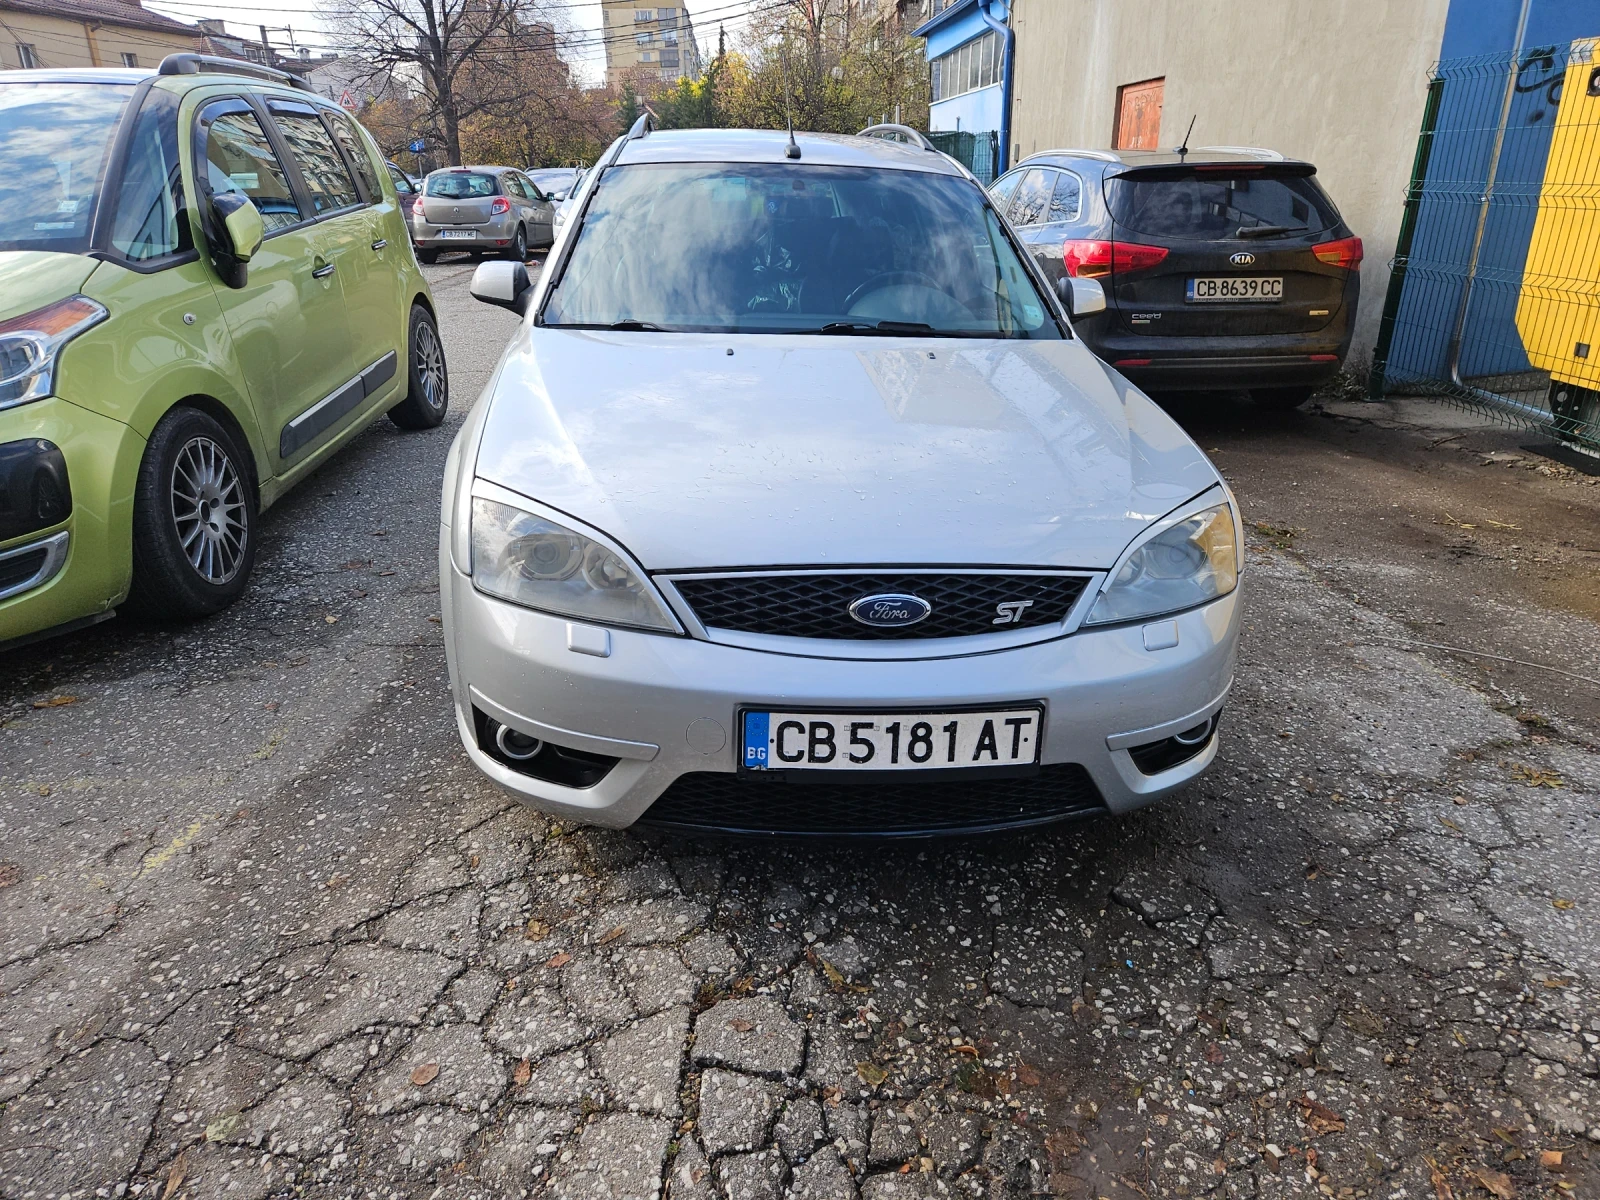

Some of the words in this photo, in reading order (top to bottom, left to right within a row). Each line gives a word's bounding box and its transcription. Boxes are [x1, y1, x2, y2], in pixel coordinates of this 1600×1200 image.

[1234, 255, 1251, 264] KIA
[869, 601, 911, 620] Ford
[992, 600, 1034, 625] ST
[747, 746, 766, 760] BG
